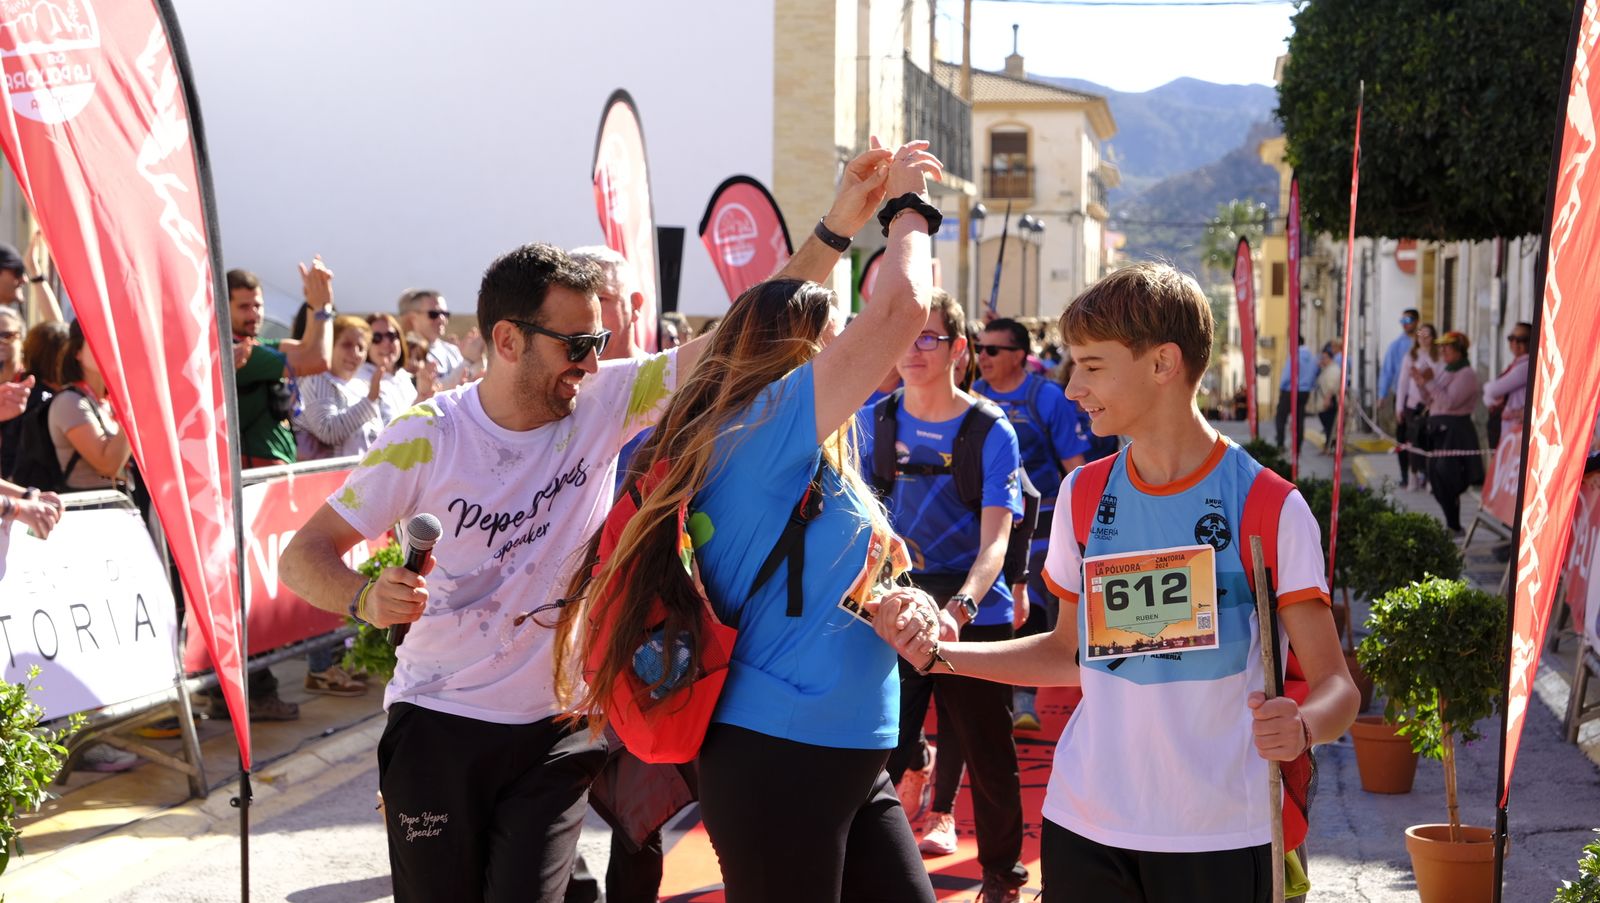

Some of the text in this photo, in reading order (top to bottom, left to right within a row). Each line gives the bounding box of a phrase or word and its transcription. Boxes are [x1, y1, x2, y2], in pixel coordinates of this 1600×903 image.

[447, 498, 526, 548] Pepe
[1155, 554, 1185, 563] CANTORIA
[1095, 562, 1141, 576] LA PÓLVORA
[1104, 571, 1188, 612] 612
[1135, 613, 1159, 622] RUBEN
[398, 811, 449, 829] Pepe Yepes
